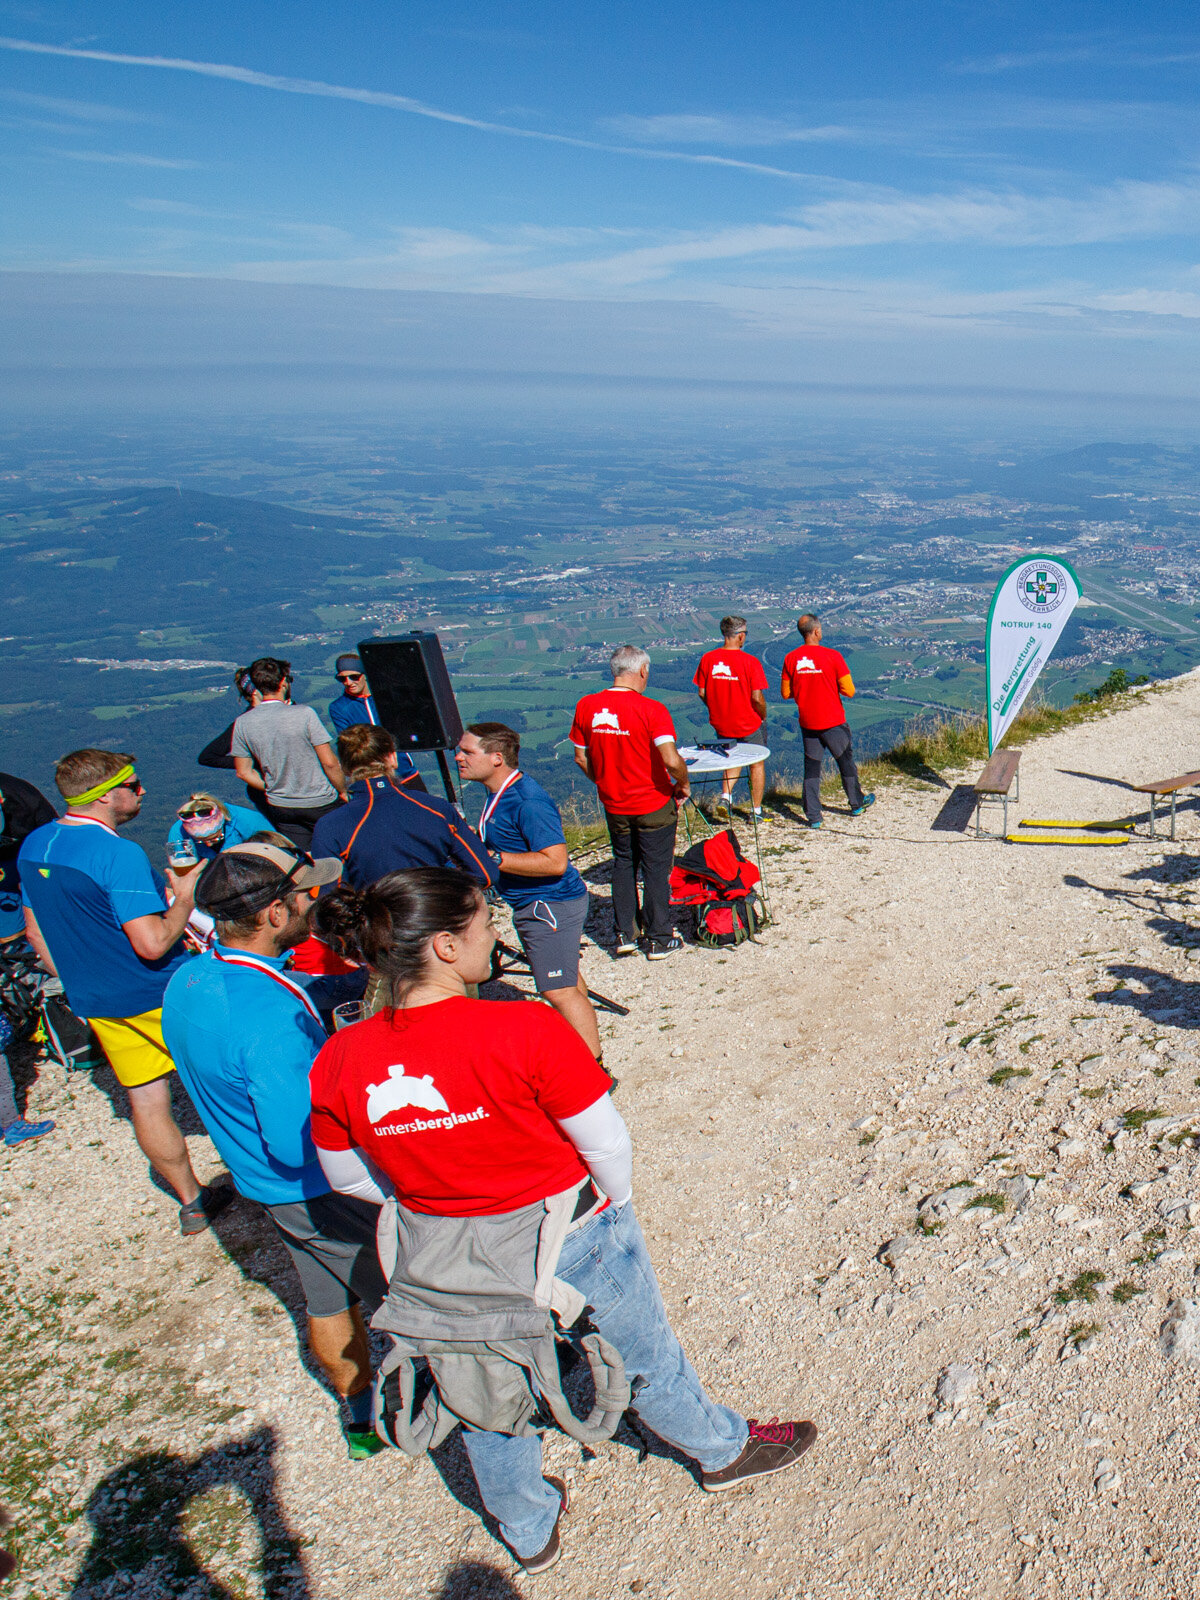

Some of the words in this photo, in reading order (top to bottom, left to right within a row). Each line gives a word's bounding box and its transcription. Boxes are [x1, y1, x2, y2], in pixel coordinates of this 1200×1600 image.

[1018, 563, 1066, 590] BERGRETTUNGSDIENST
[1022, 597, 1061, 612] ÖSTERREICH
[1001, 621, 1035, 629] NOTRUF
[1037, 622, 1052, 630] 140
[992, 694, 1005, 712] Die
[1002, 635, 1036, 693] Bergrettung
[374, 1106, 490, 1136] untersberglauf.
